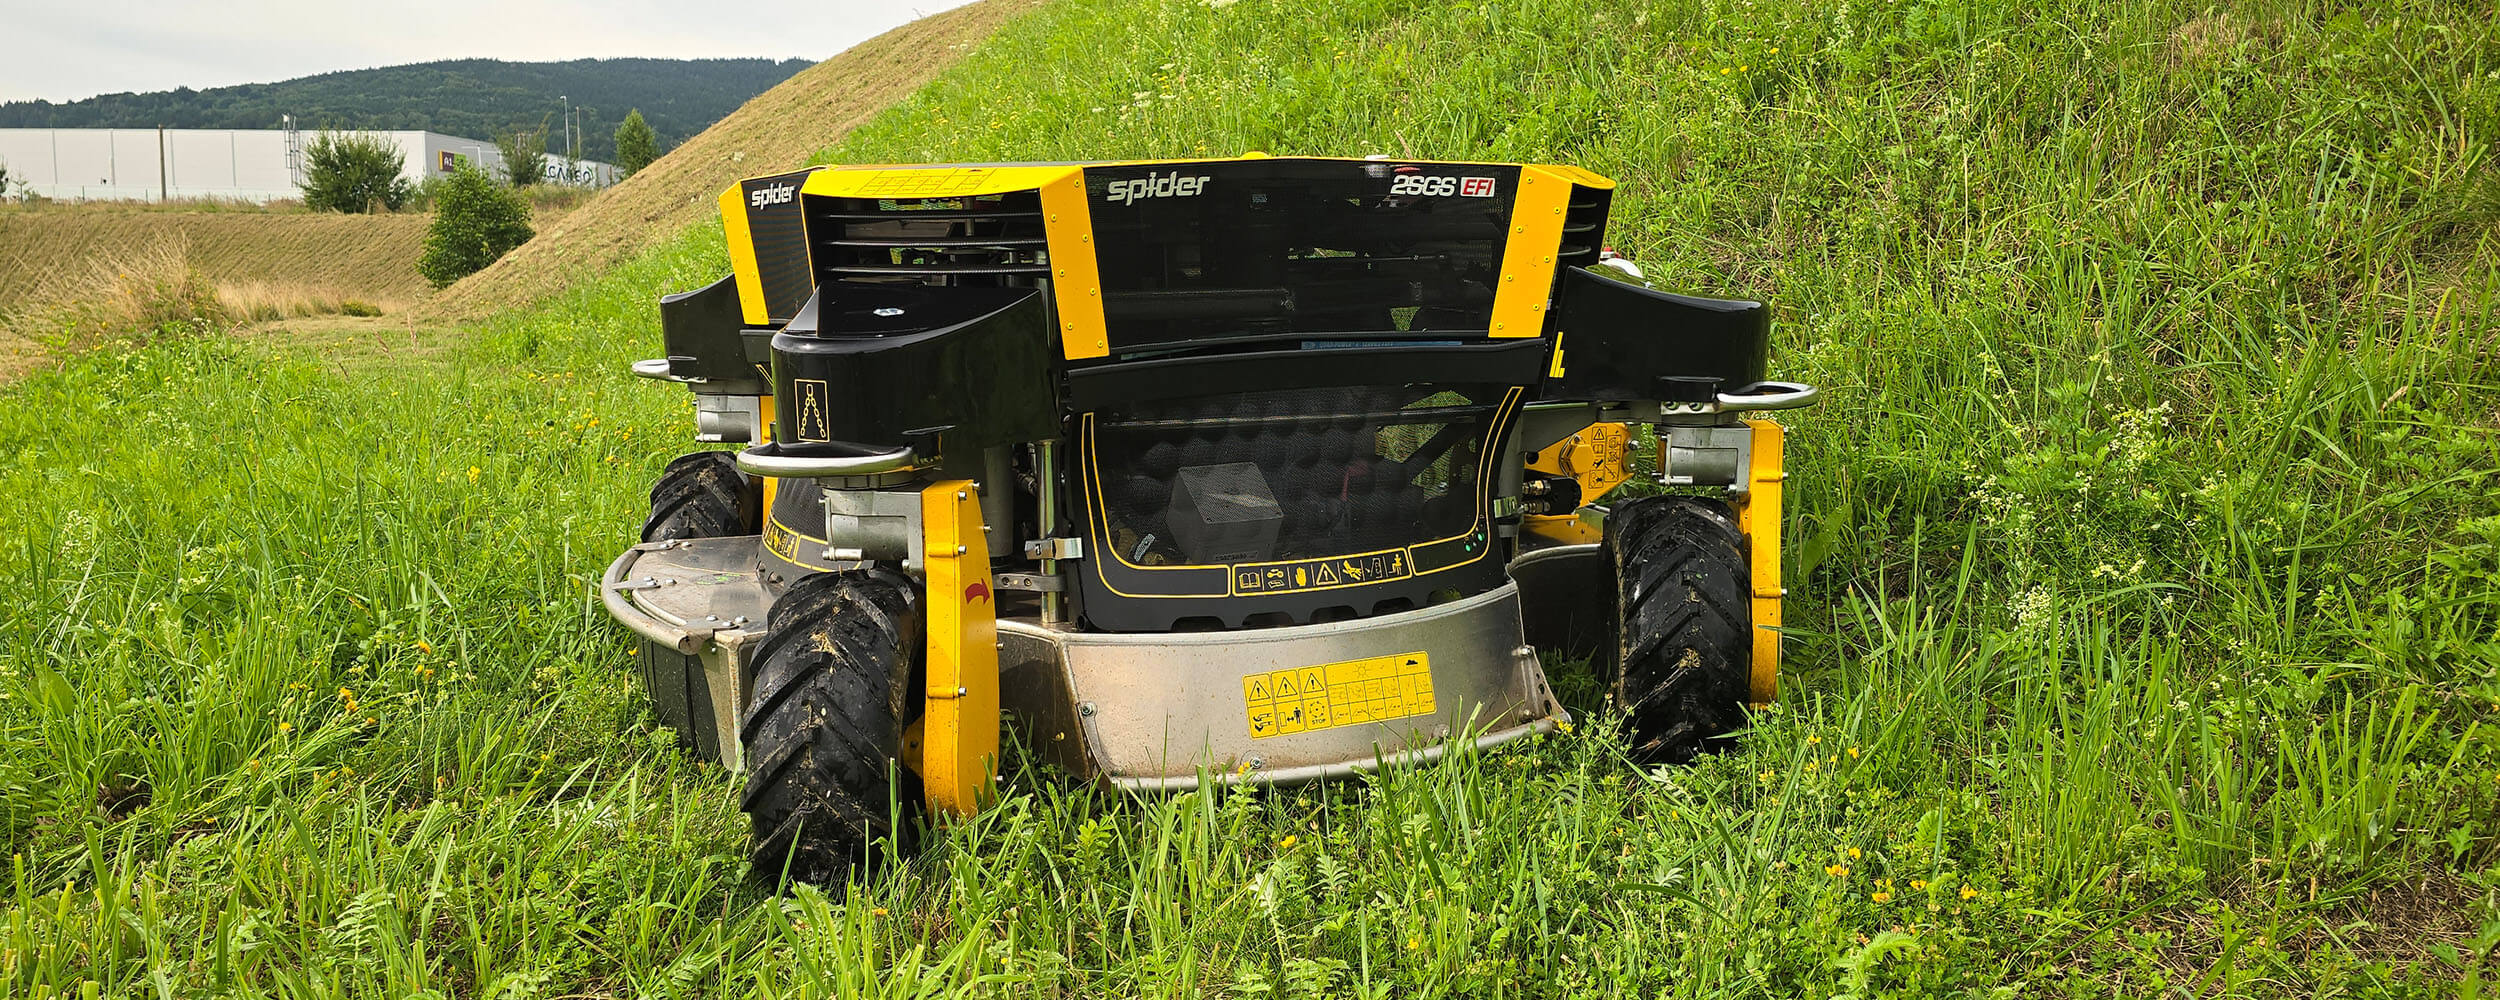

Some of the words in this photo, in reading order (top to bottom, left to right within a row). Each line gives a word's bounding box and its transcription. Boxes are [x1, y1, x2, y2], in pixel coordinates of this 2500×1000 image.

[751, 182, 796, 210] spider
[1107, 171, 1210, 206] spider
[1390, 174, 1457, 197] 2SGS
[1462, 179, 1493, 196] EFI
